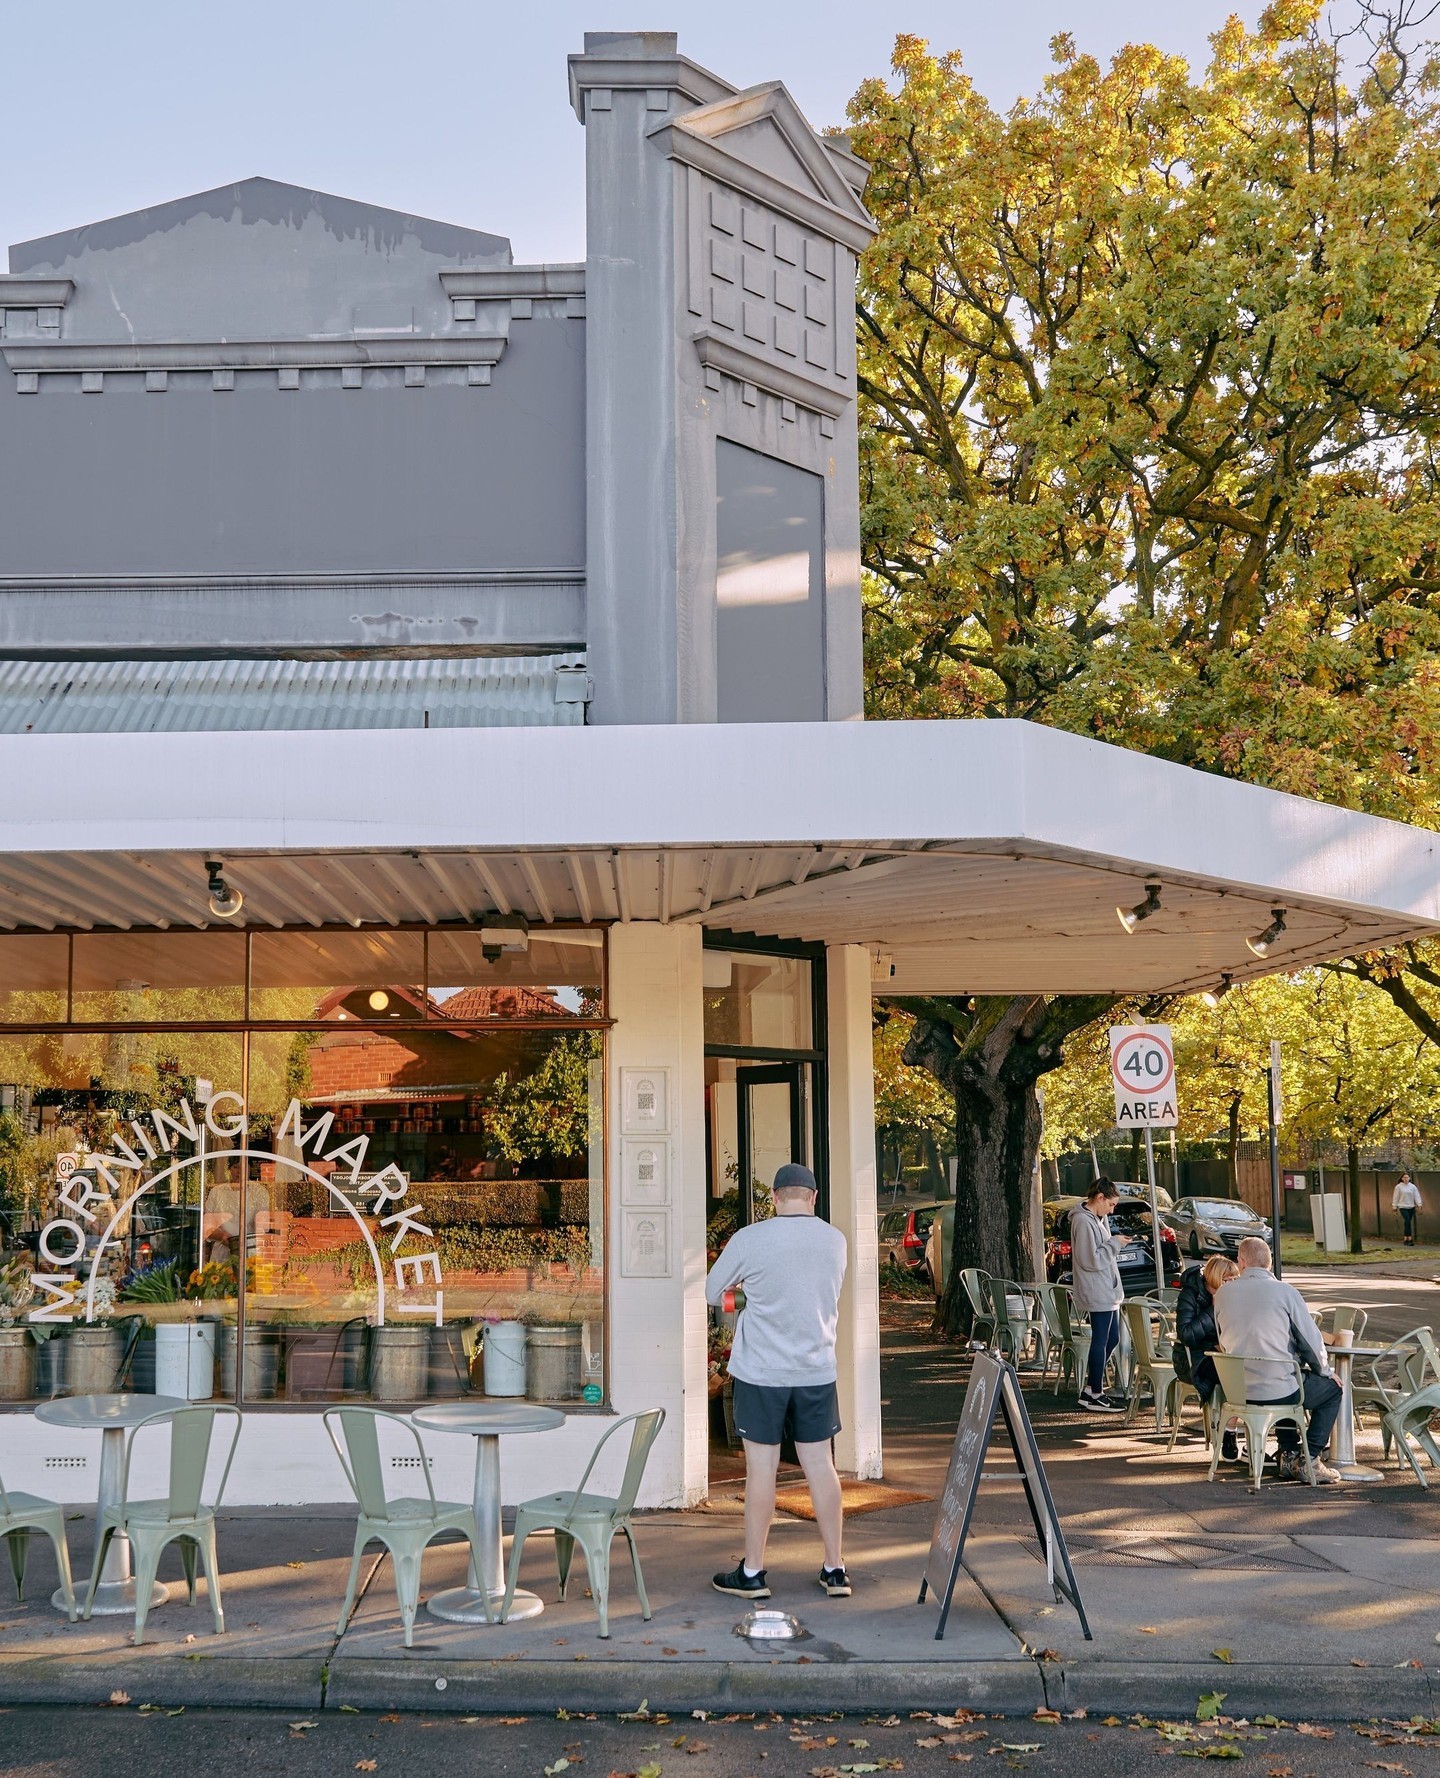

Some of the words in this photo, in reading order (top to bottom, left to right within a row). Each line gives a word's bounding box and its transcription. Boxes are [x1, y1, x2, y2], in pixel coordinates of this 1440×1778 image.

[1123, 1050, 1164, 1077] 40
[1119, 1101, 1176, 1120] AREA
[28, 1090, 249, 1323] MORNING
[276, 1098, 444, 1328] MARKET
